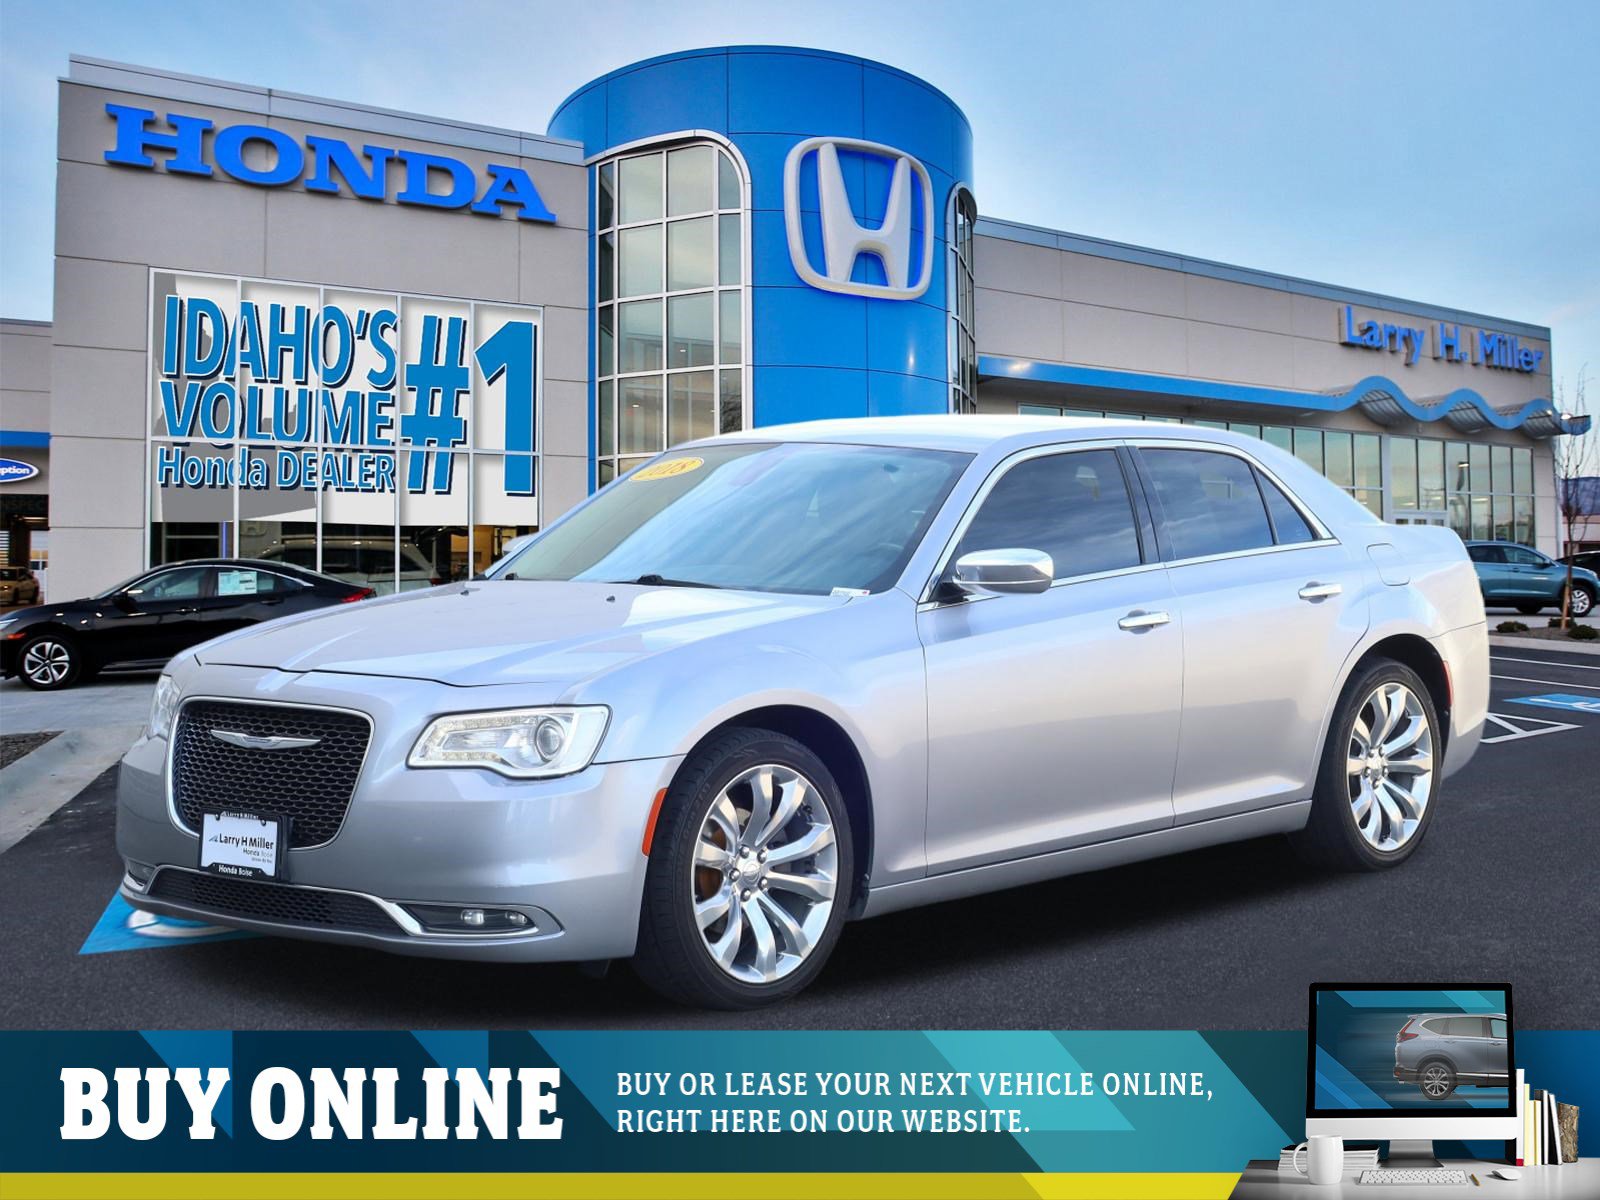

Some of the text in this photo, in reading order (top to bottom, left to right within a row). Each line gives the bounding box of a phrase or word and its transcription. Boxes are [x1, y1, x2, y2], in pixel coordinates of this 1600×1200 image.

[104, 103, 558, 224] HONDA
[162, 294, 402, 389] IDAHO'S
[1338, 304, 1546, 375] Larry H. Miller
[159, 380, 399, 452] VOLUME
[399, 313, 539, 498] #1
[156, 446, 398, 495] Honda DEALER
[218, 863, 238, 875] Honda
[219, 832, 274, 850] Larry H Miller
[243, 848, 260, 857] Honda
